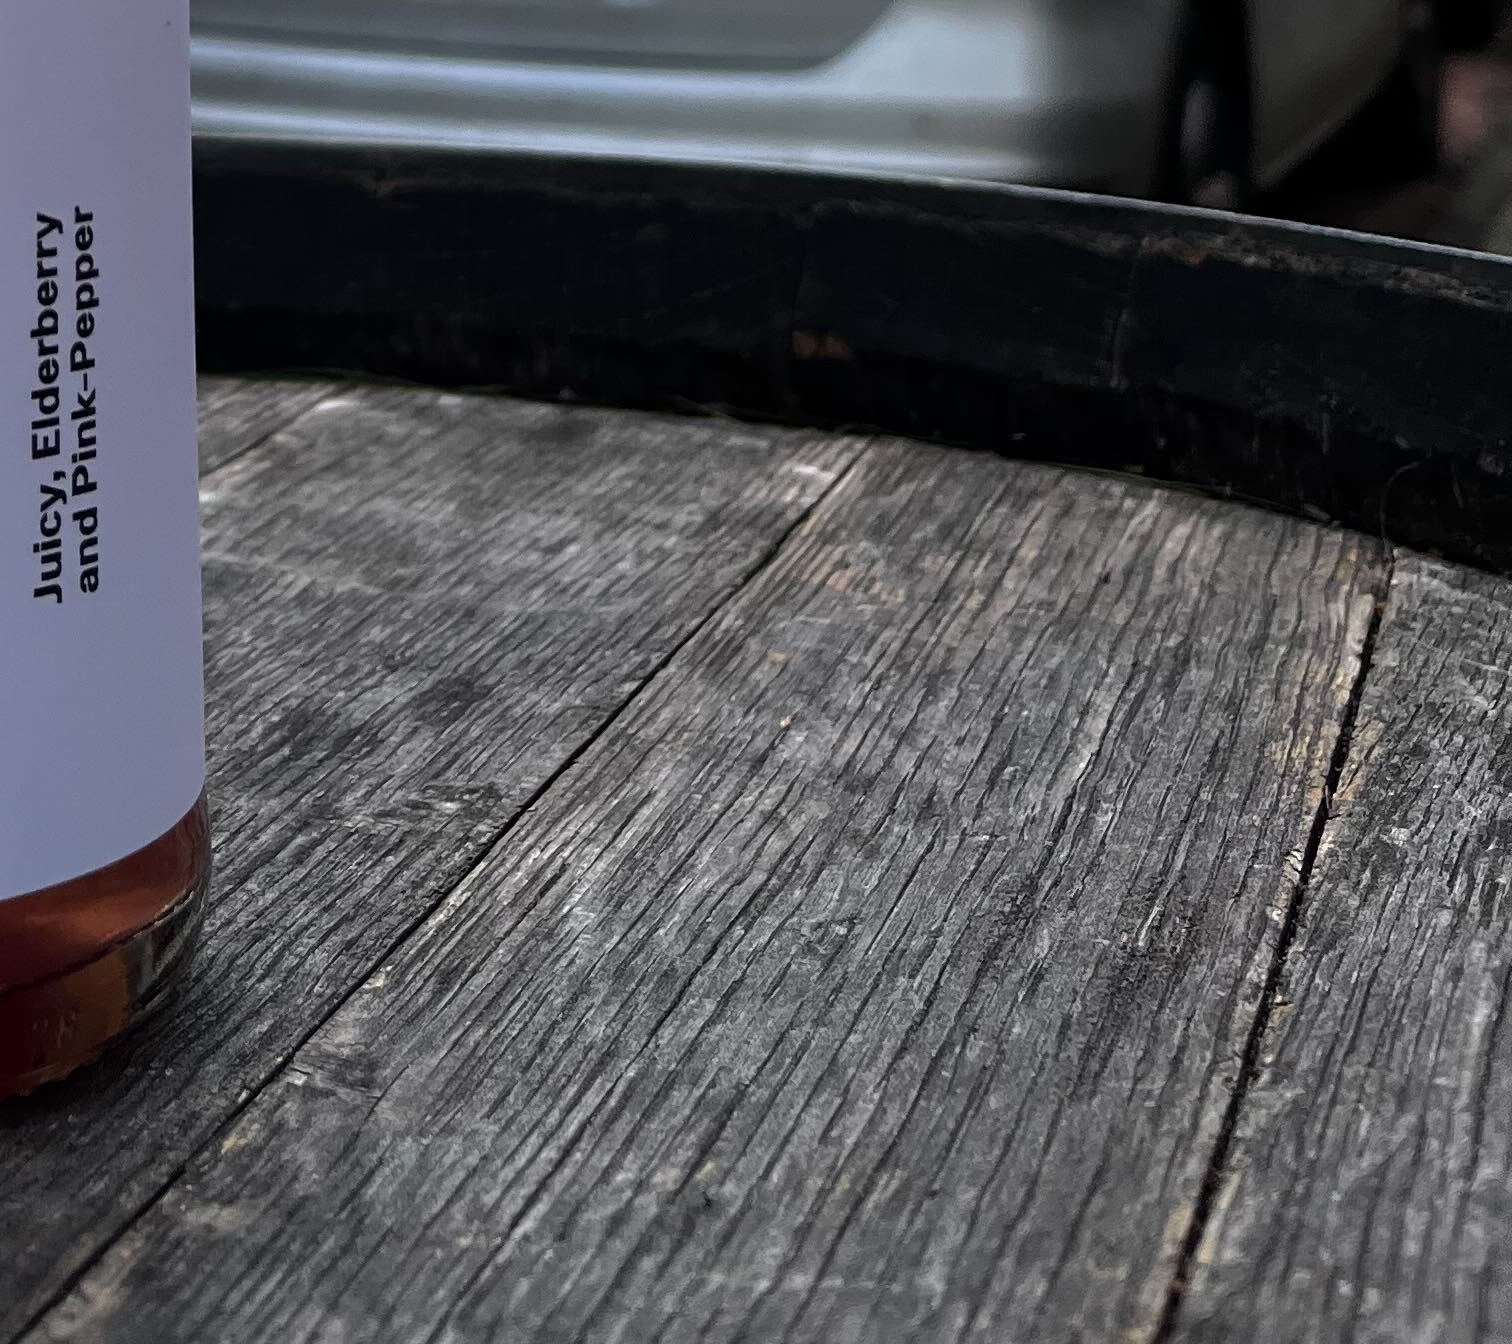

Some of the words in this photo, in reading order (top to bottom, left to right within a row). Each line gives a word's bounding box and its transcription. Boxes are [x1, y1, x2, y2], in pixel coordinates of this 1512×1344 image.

[29, 212, 64, 460] Elderberry
[69, 205, 100, 497] Pink-Pepper
[32, 470, 68, 604] Juicy,
[72, 506, 99, 594] and
